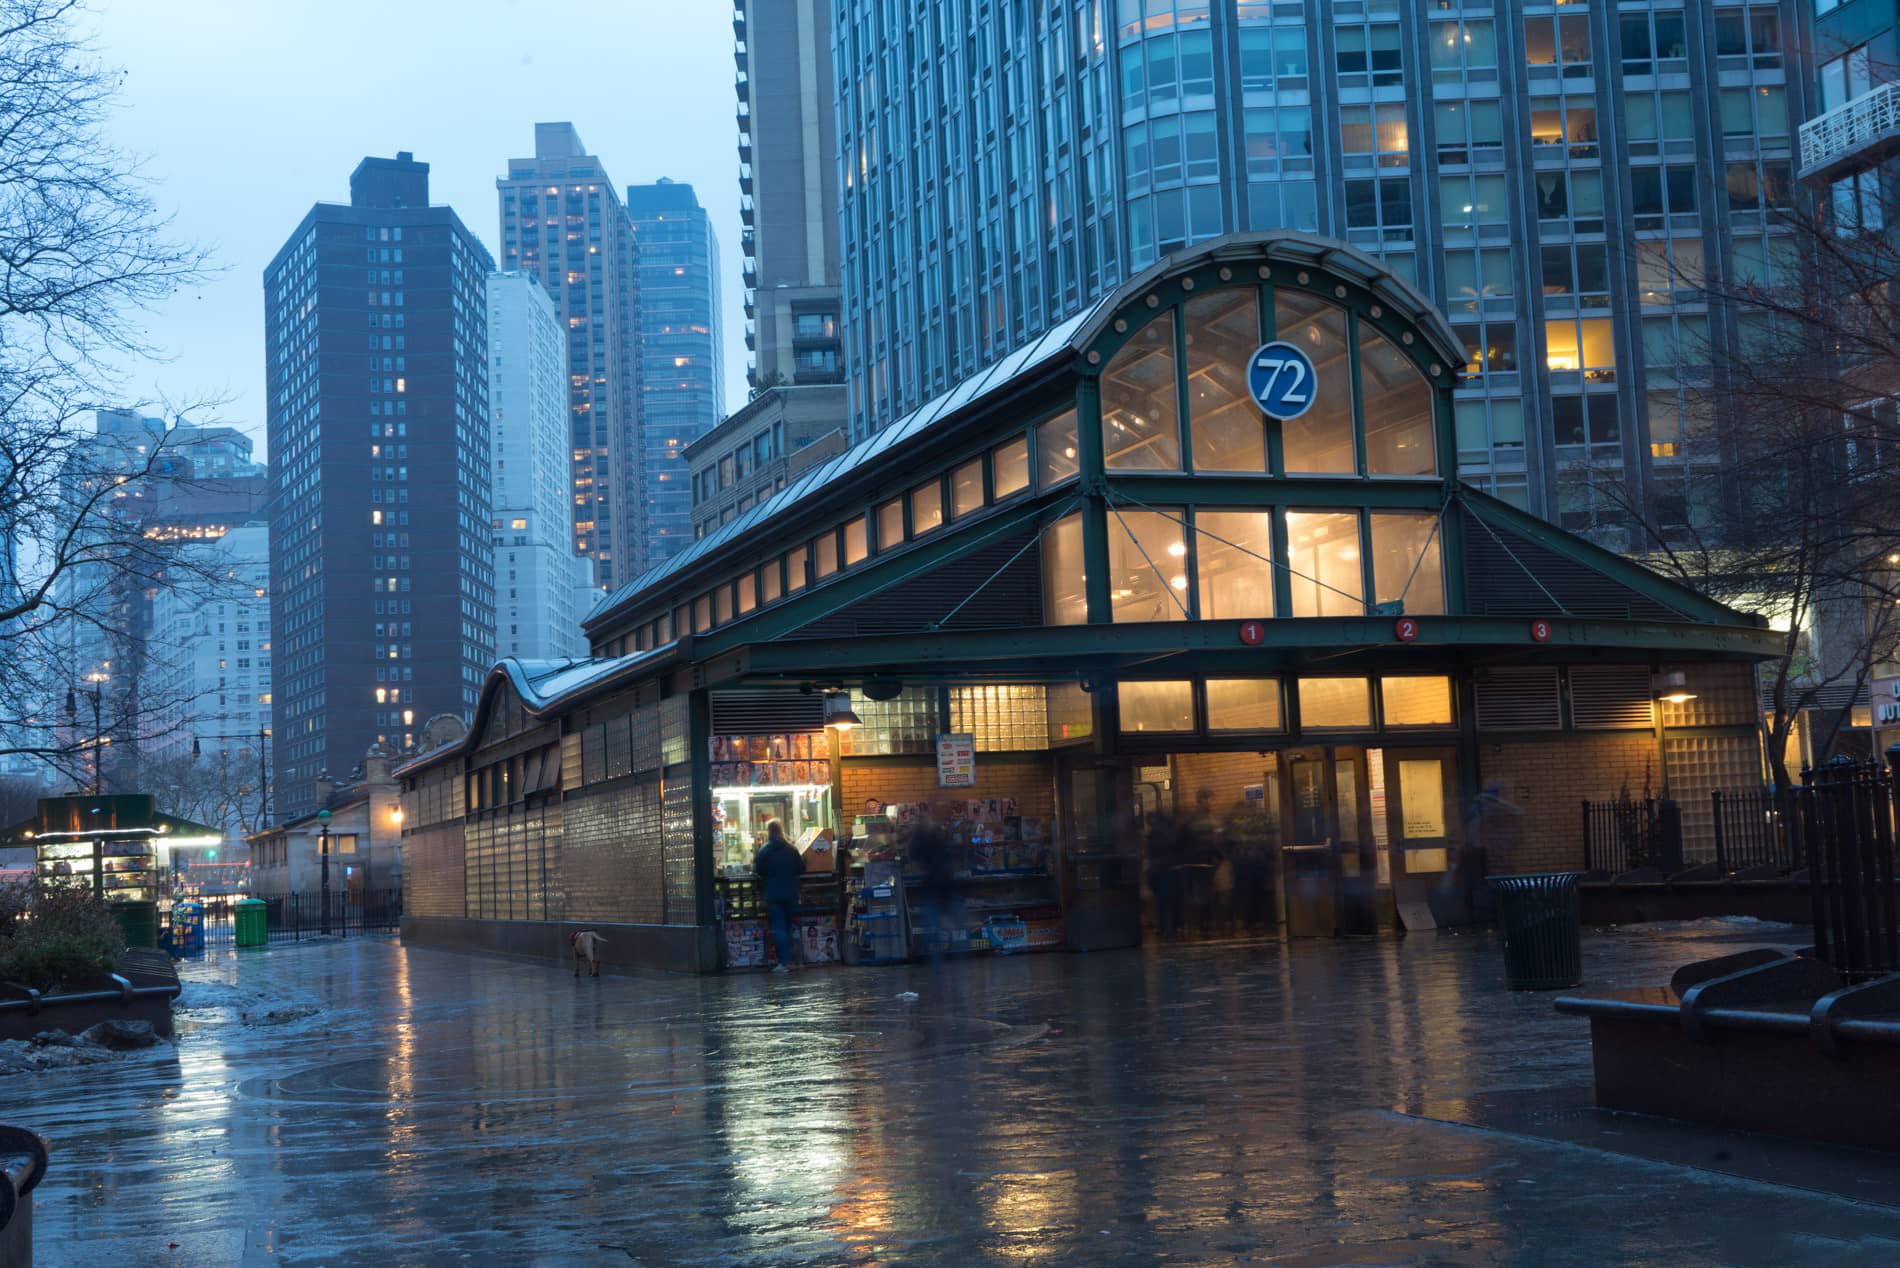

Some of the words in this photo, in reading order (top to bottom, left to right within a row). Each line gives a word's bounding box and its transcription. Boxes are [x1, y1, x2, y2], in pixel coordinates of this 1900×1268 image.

[1257, 358, 1307, 402] 72
[1247, 625, 1256, 640] 1
[1403, 622, 1413, 637] 2
[1537, 623, 1546, 637] 3
